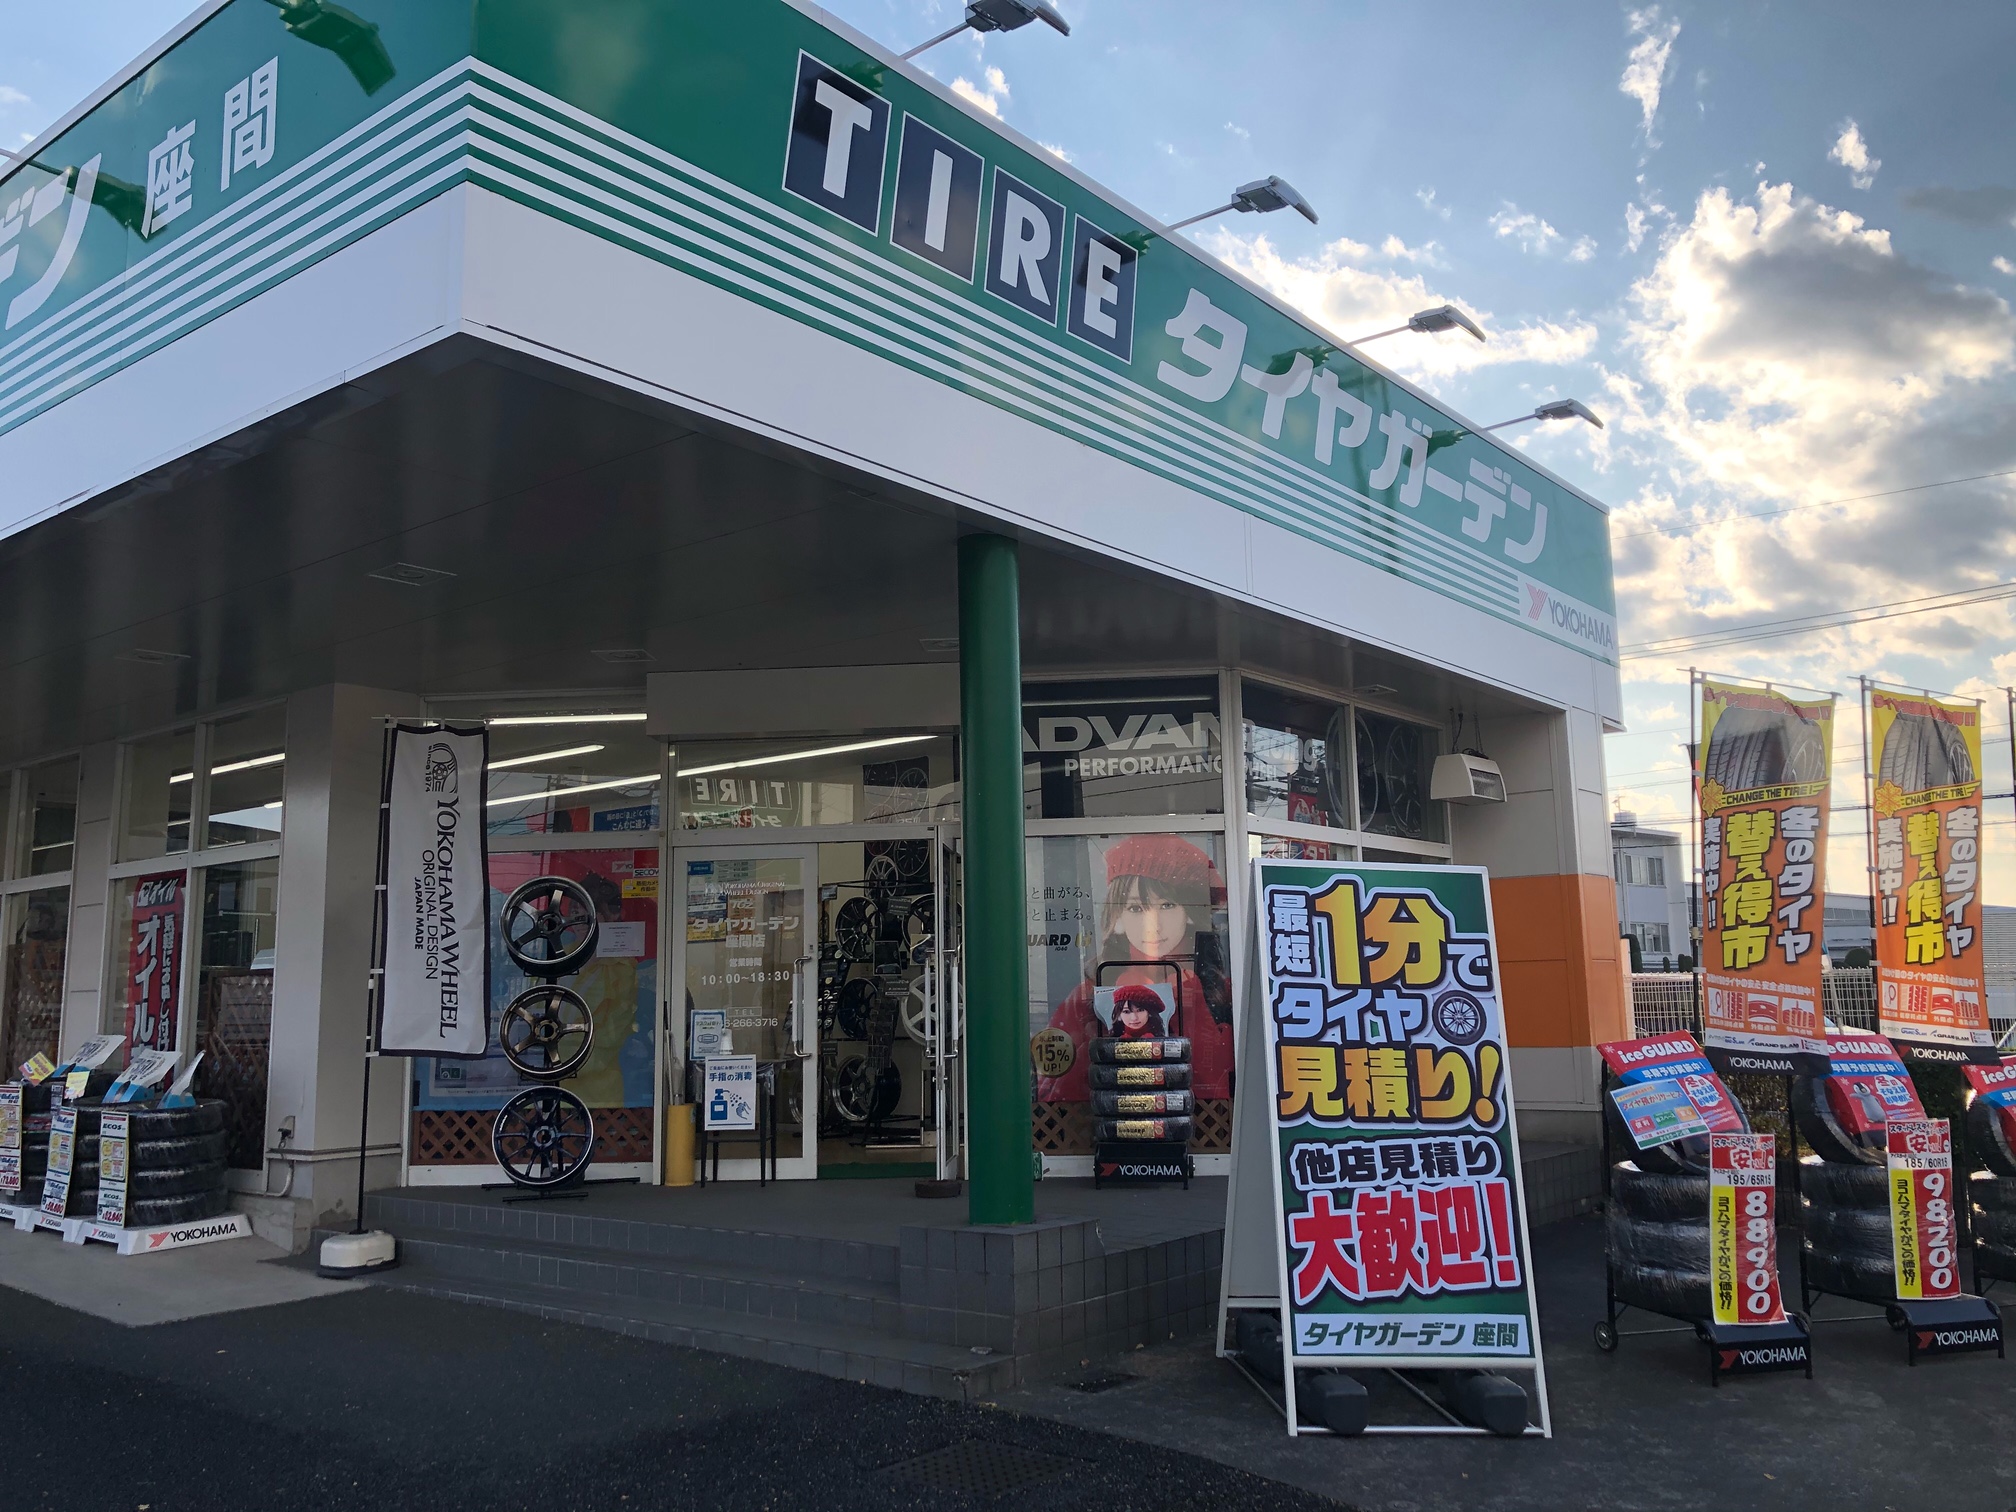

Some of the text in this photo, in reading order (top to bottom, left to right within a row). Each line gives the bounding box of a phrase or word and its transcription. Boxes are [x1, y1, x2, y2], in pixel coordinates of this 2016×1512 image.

[141, 56, 278, 238] 座間
[815, 79, 1547, 563] TIRE タイヤガーデン
[1548, 597, 1613, 649] YOKOHAMA
[1726, 791, 1766, 805] CHANGE
[1767, 788, 1782, 799] THE
[1721, 810, 1776, 969] 替え得市
[1777, 805, 1820, 963] 冬のタイヤ
[1905, 811, 1945, 964] 替え得市
[1944, 806, 1980, 957] 冬のタイヤ
[414, 877, 424, 950] JAPAN MADE
[422, 850, 438, 979] ORIGINAL DESIGN
[437, 798, 460, 1038] YOKOHAMA WHEEL
[692, 915, 799, 932] タイヤガーデン
[725, 934, 766, 947] 座間店
[1278, 988, 1423, 1043] タイヤ
[1036, 1044, 1070, 1062] 15%
[1618, 1040, 1696, 1064] iceGUARD
[1911, 1047, 1971, 1061] YOKOHAMA
[1043, 1063, 1062, 1072] UP!
[1729, 1057, 1795, 1070] YOKOHAMA
[709, 1072, 752, 1082] 手指の消毒
[102, 1123, 122, 1131] ECOS
[1119, 1164, 1183, 1176] YOKOHAMA
[1295, 1140, 1497, 1185] 他店見積り
[1905, 1157, 1948, 1168] 185/60R15
[1727, 1174, 1771, 1185] 195/65R15
[170, 1222, 238, 1243] YOKOHAMA
[1293, 1182, 1517, 1300] 大歓迎!
[1302, 1321, 1519, 1348] タイヤガーデン 座間
[1935, 1328, 1999, 1346] YOKOHAMA
[1739, 1346, 1807, 1365] YOKOHAMA
